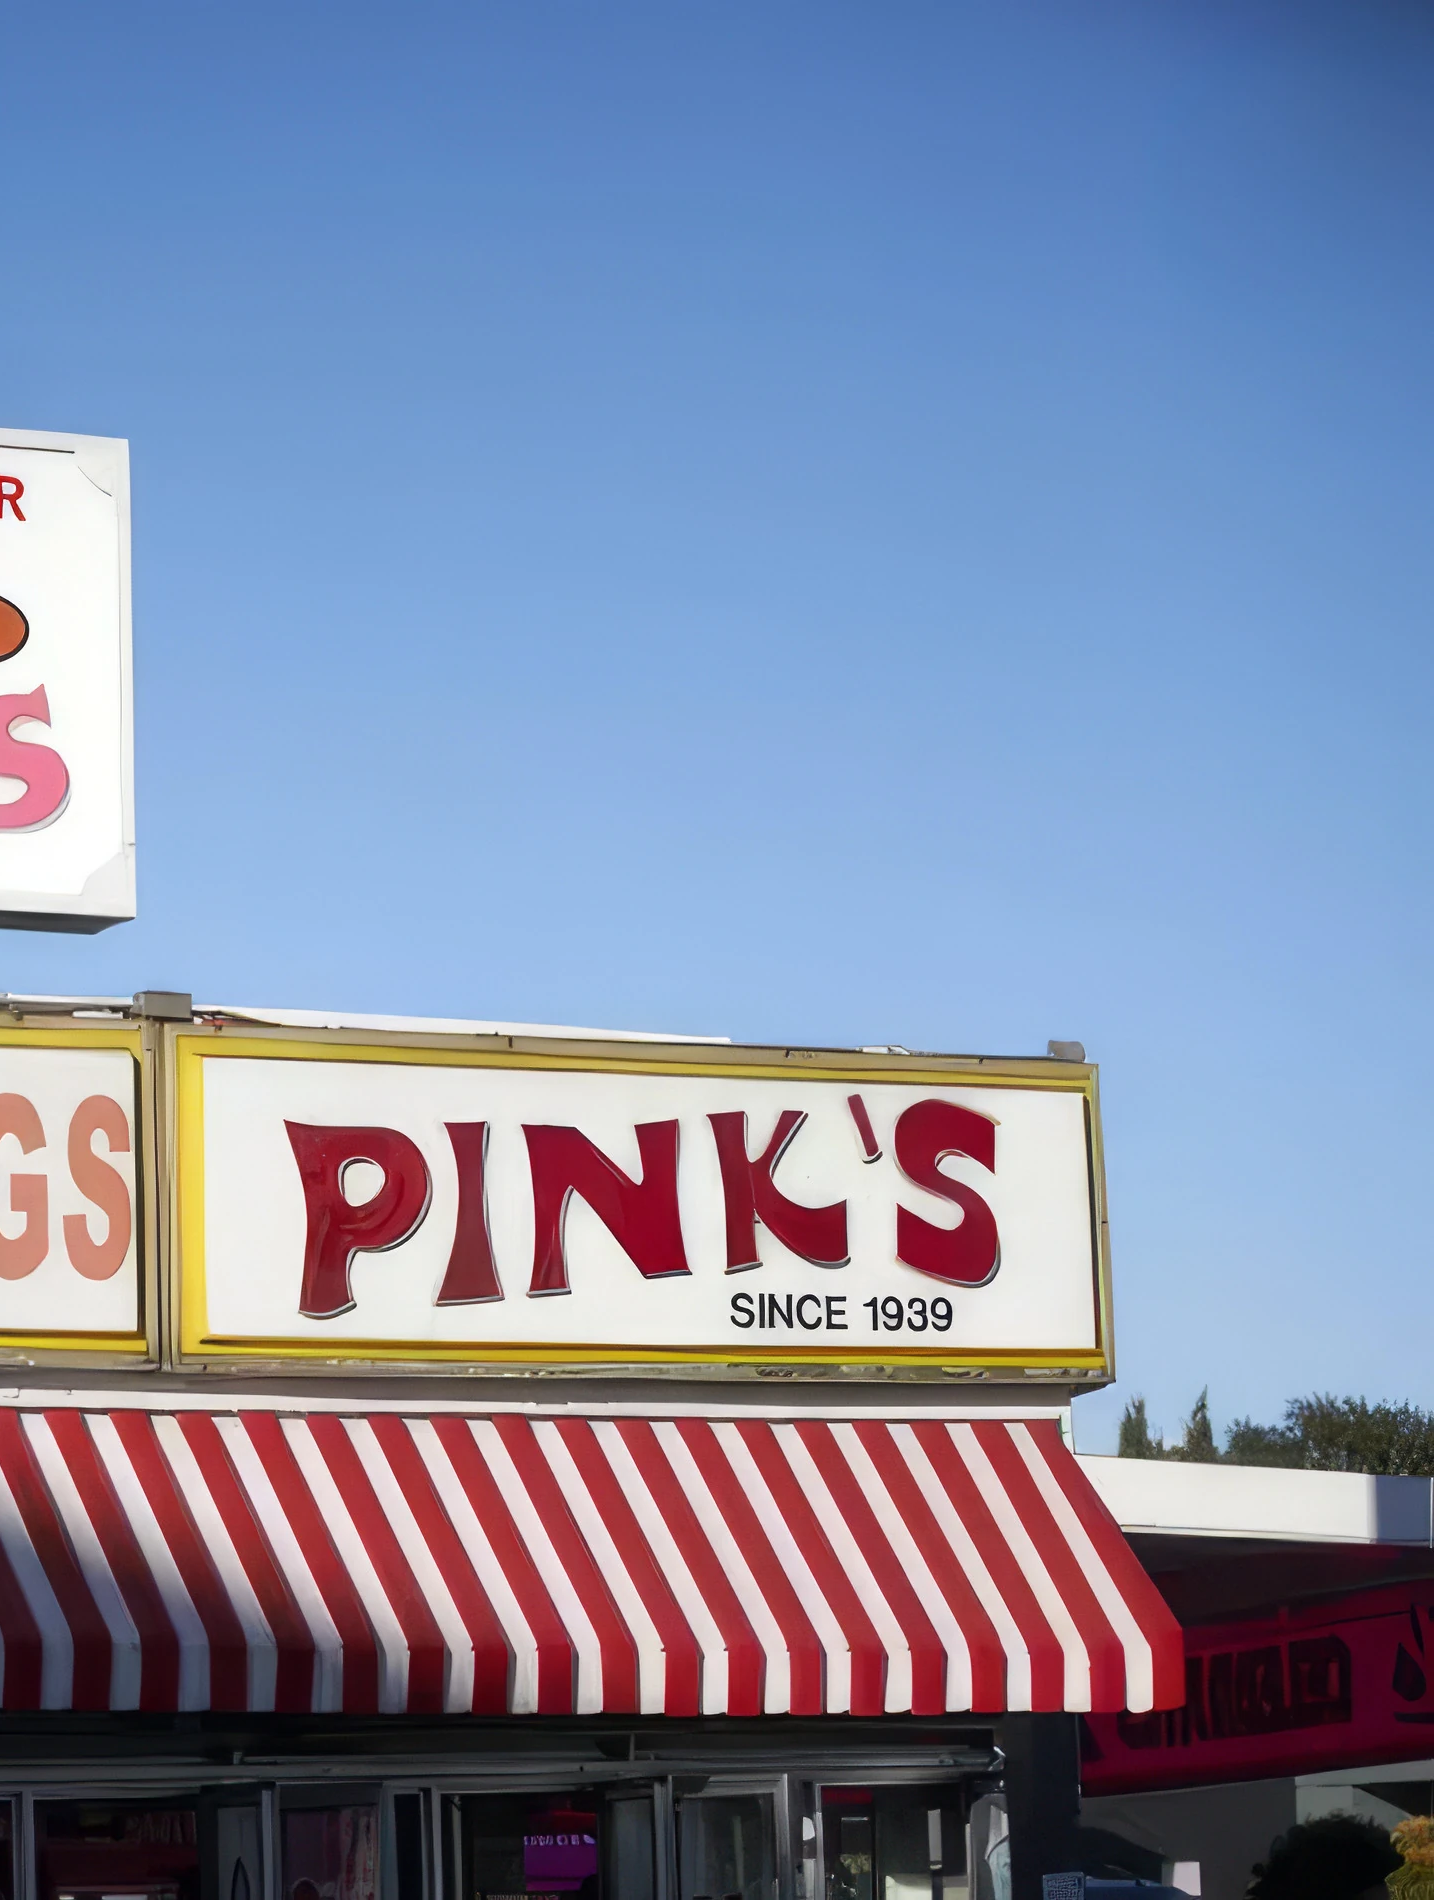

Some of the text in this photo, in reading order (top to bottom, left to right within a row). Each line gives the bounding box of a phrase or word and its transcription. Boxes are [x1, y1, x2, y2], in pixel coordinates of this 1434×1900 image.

[283, 1093, 1001, 1320] PINK'S
[730, 1292, 954, 1333] SINCE 1939
